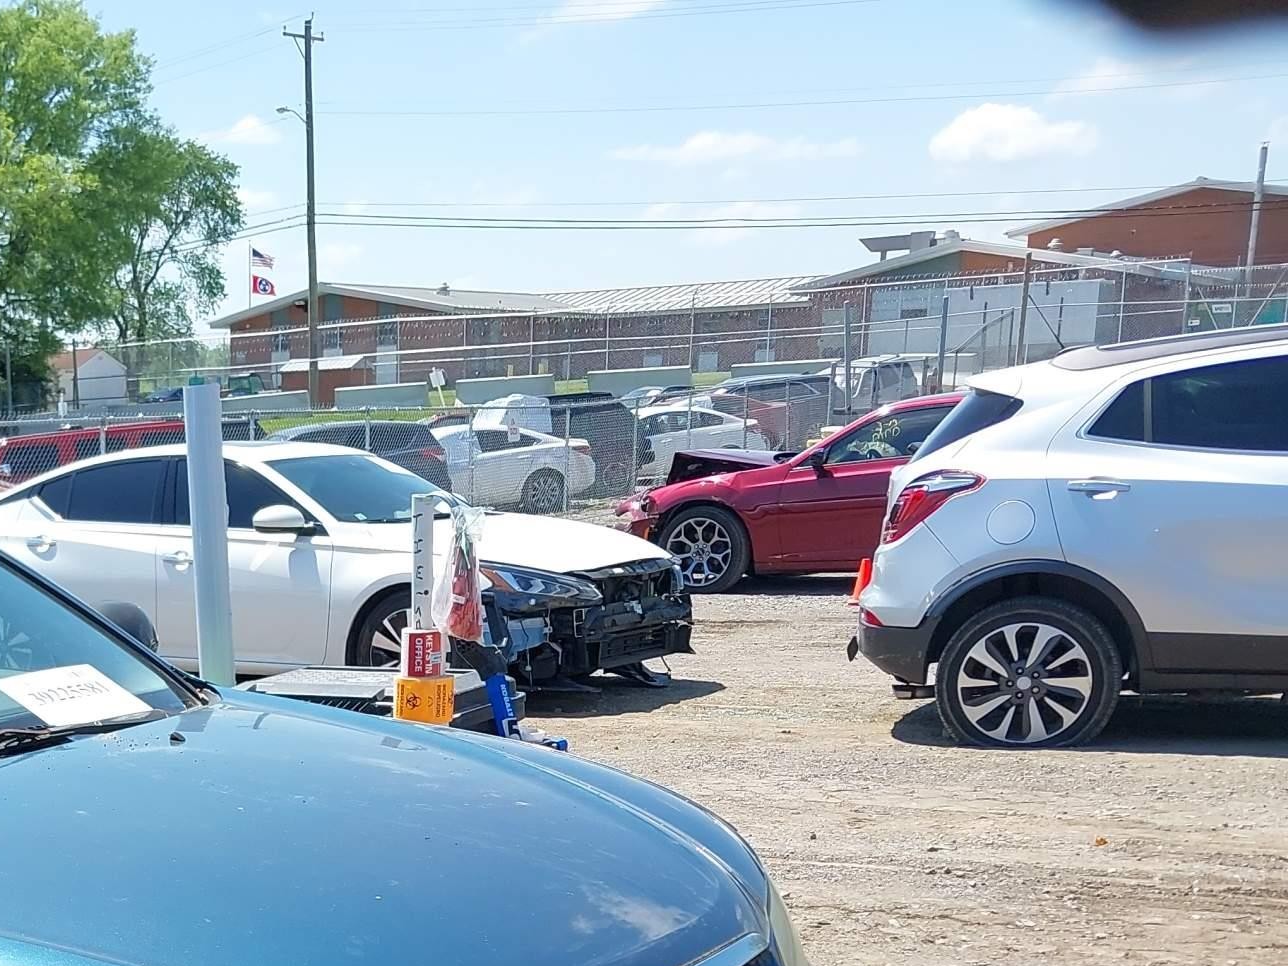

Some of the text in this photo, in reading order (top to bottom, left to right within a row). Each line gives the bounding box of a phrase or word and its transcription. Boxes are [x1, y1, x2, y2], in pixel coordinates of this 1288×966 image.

[414, 637, 423, 673] OFFICE
[425, 634, 433, 674] KEYS IN
[27, 680, 110, 706] 39225581
